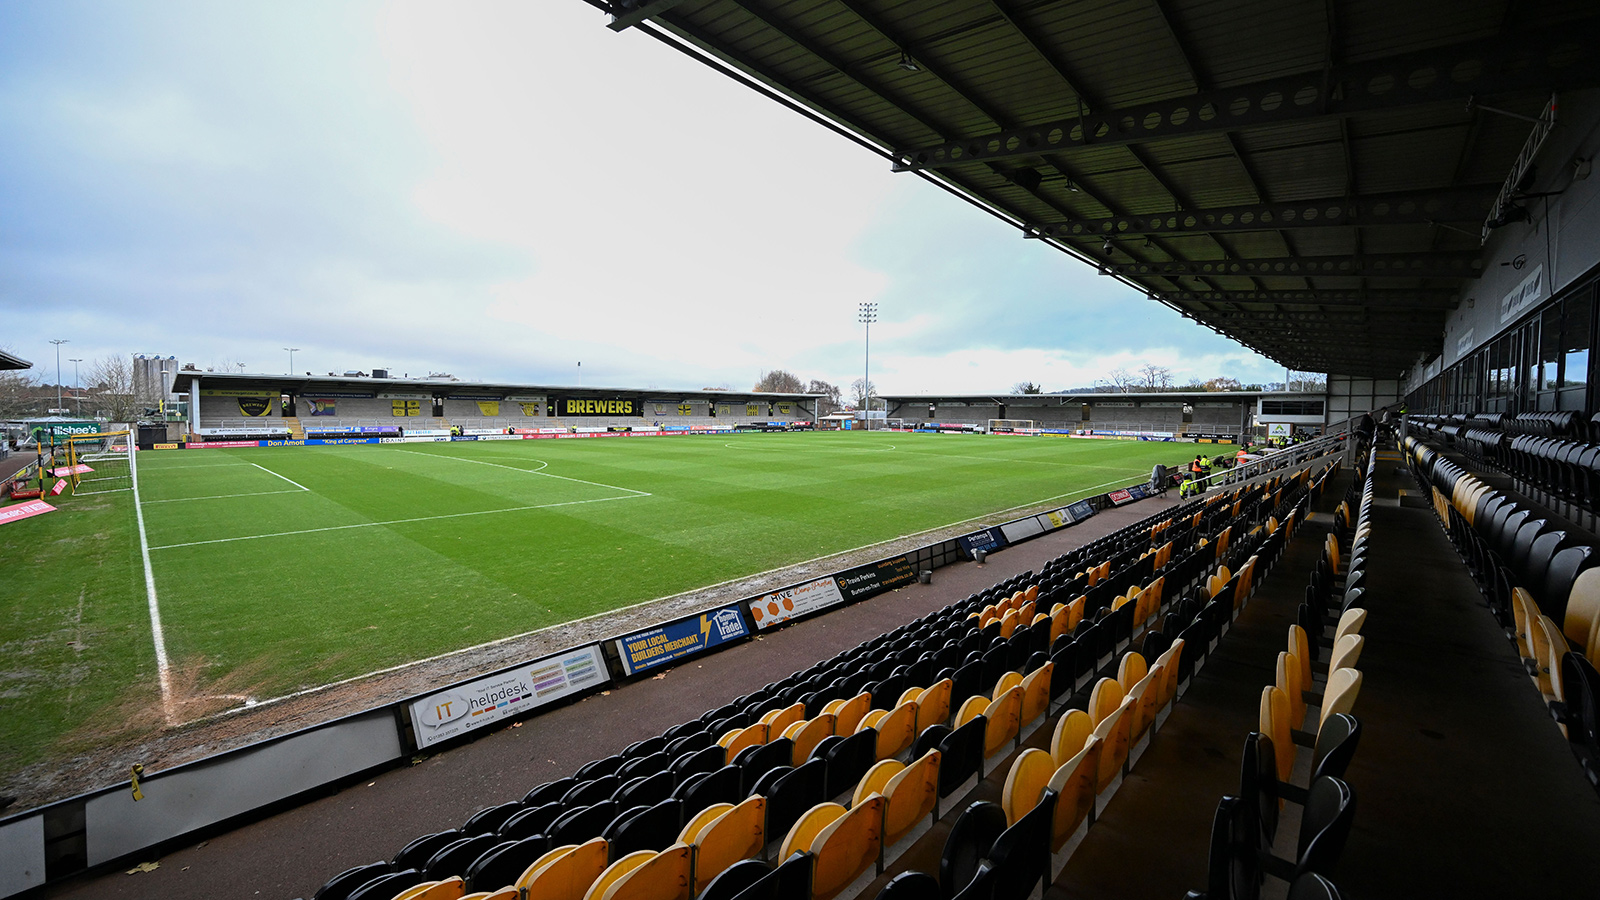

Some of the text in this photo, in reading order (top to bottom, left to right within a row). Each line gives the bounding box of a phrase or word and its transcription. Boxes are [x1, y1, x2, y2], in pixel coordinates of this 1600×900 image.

[566, 399, 633, 414] BREWERS
[44, 425, 97, 435] willshee's
[846, 572, 876, 585] Travis Perkins
[770, 589, 793, 602] HIVE
[718, 612, 736, 622] home
[627, 633, 669, 653] YOUR LOCAL
[630, 645, 665, 663] BUILDERS
[663, 633, 699, 653] MERCHANT
[469, 681, 529, 709] helpdesk
[435, 701, 453, 721] IT
